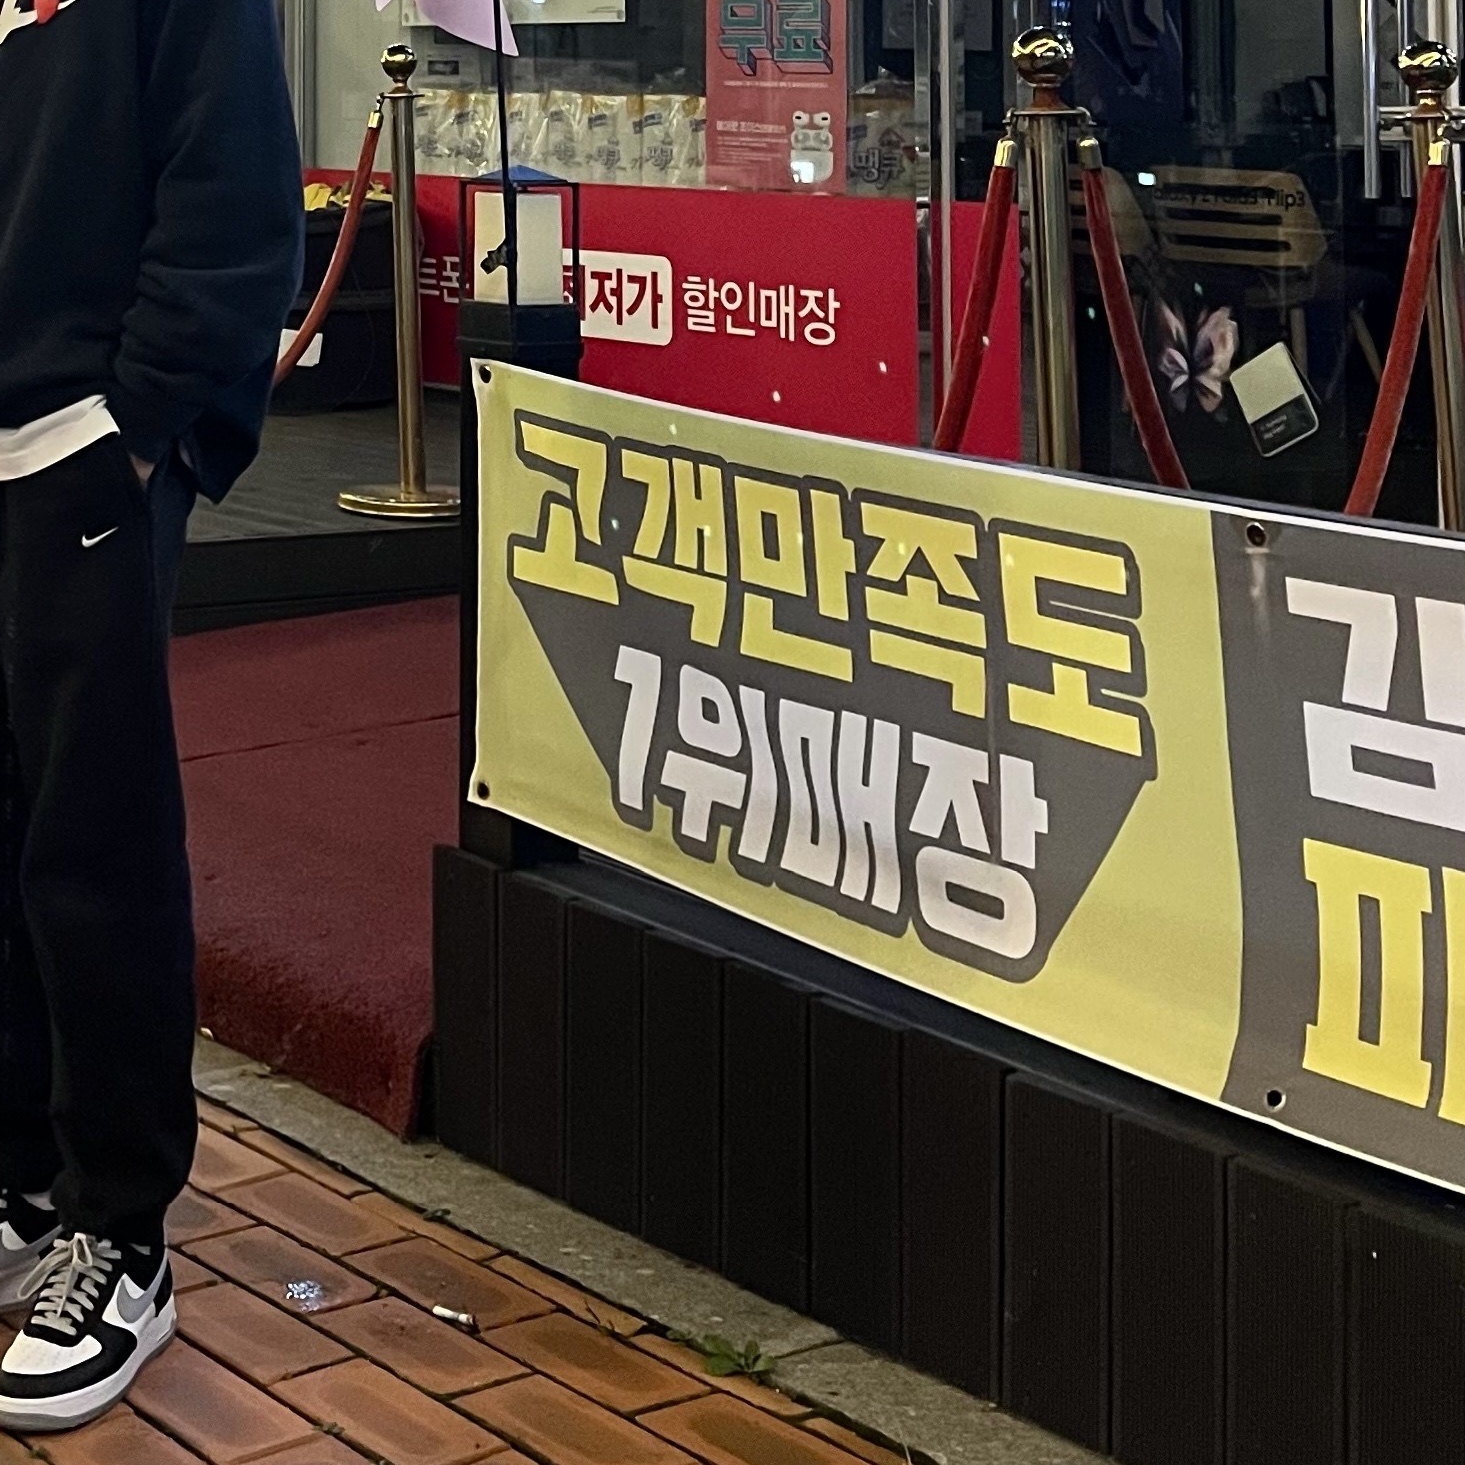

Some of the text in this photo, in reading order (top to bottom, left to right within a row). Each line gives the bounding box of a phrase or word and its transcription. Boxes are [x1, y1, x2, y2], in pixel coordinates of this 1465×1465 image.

[682, 275, 841, 347] 할인매장
[510, 418, 1146, 760] 고객만족도
[613, 643, 1050, 960] 1위매장
